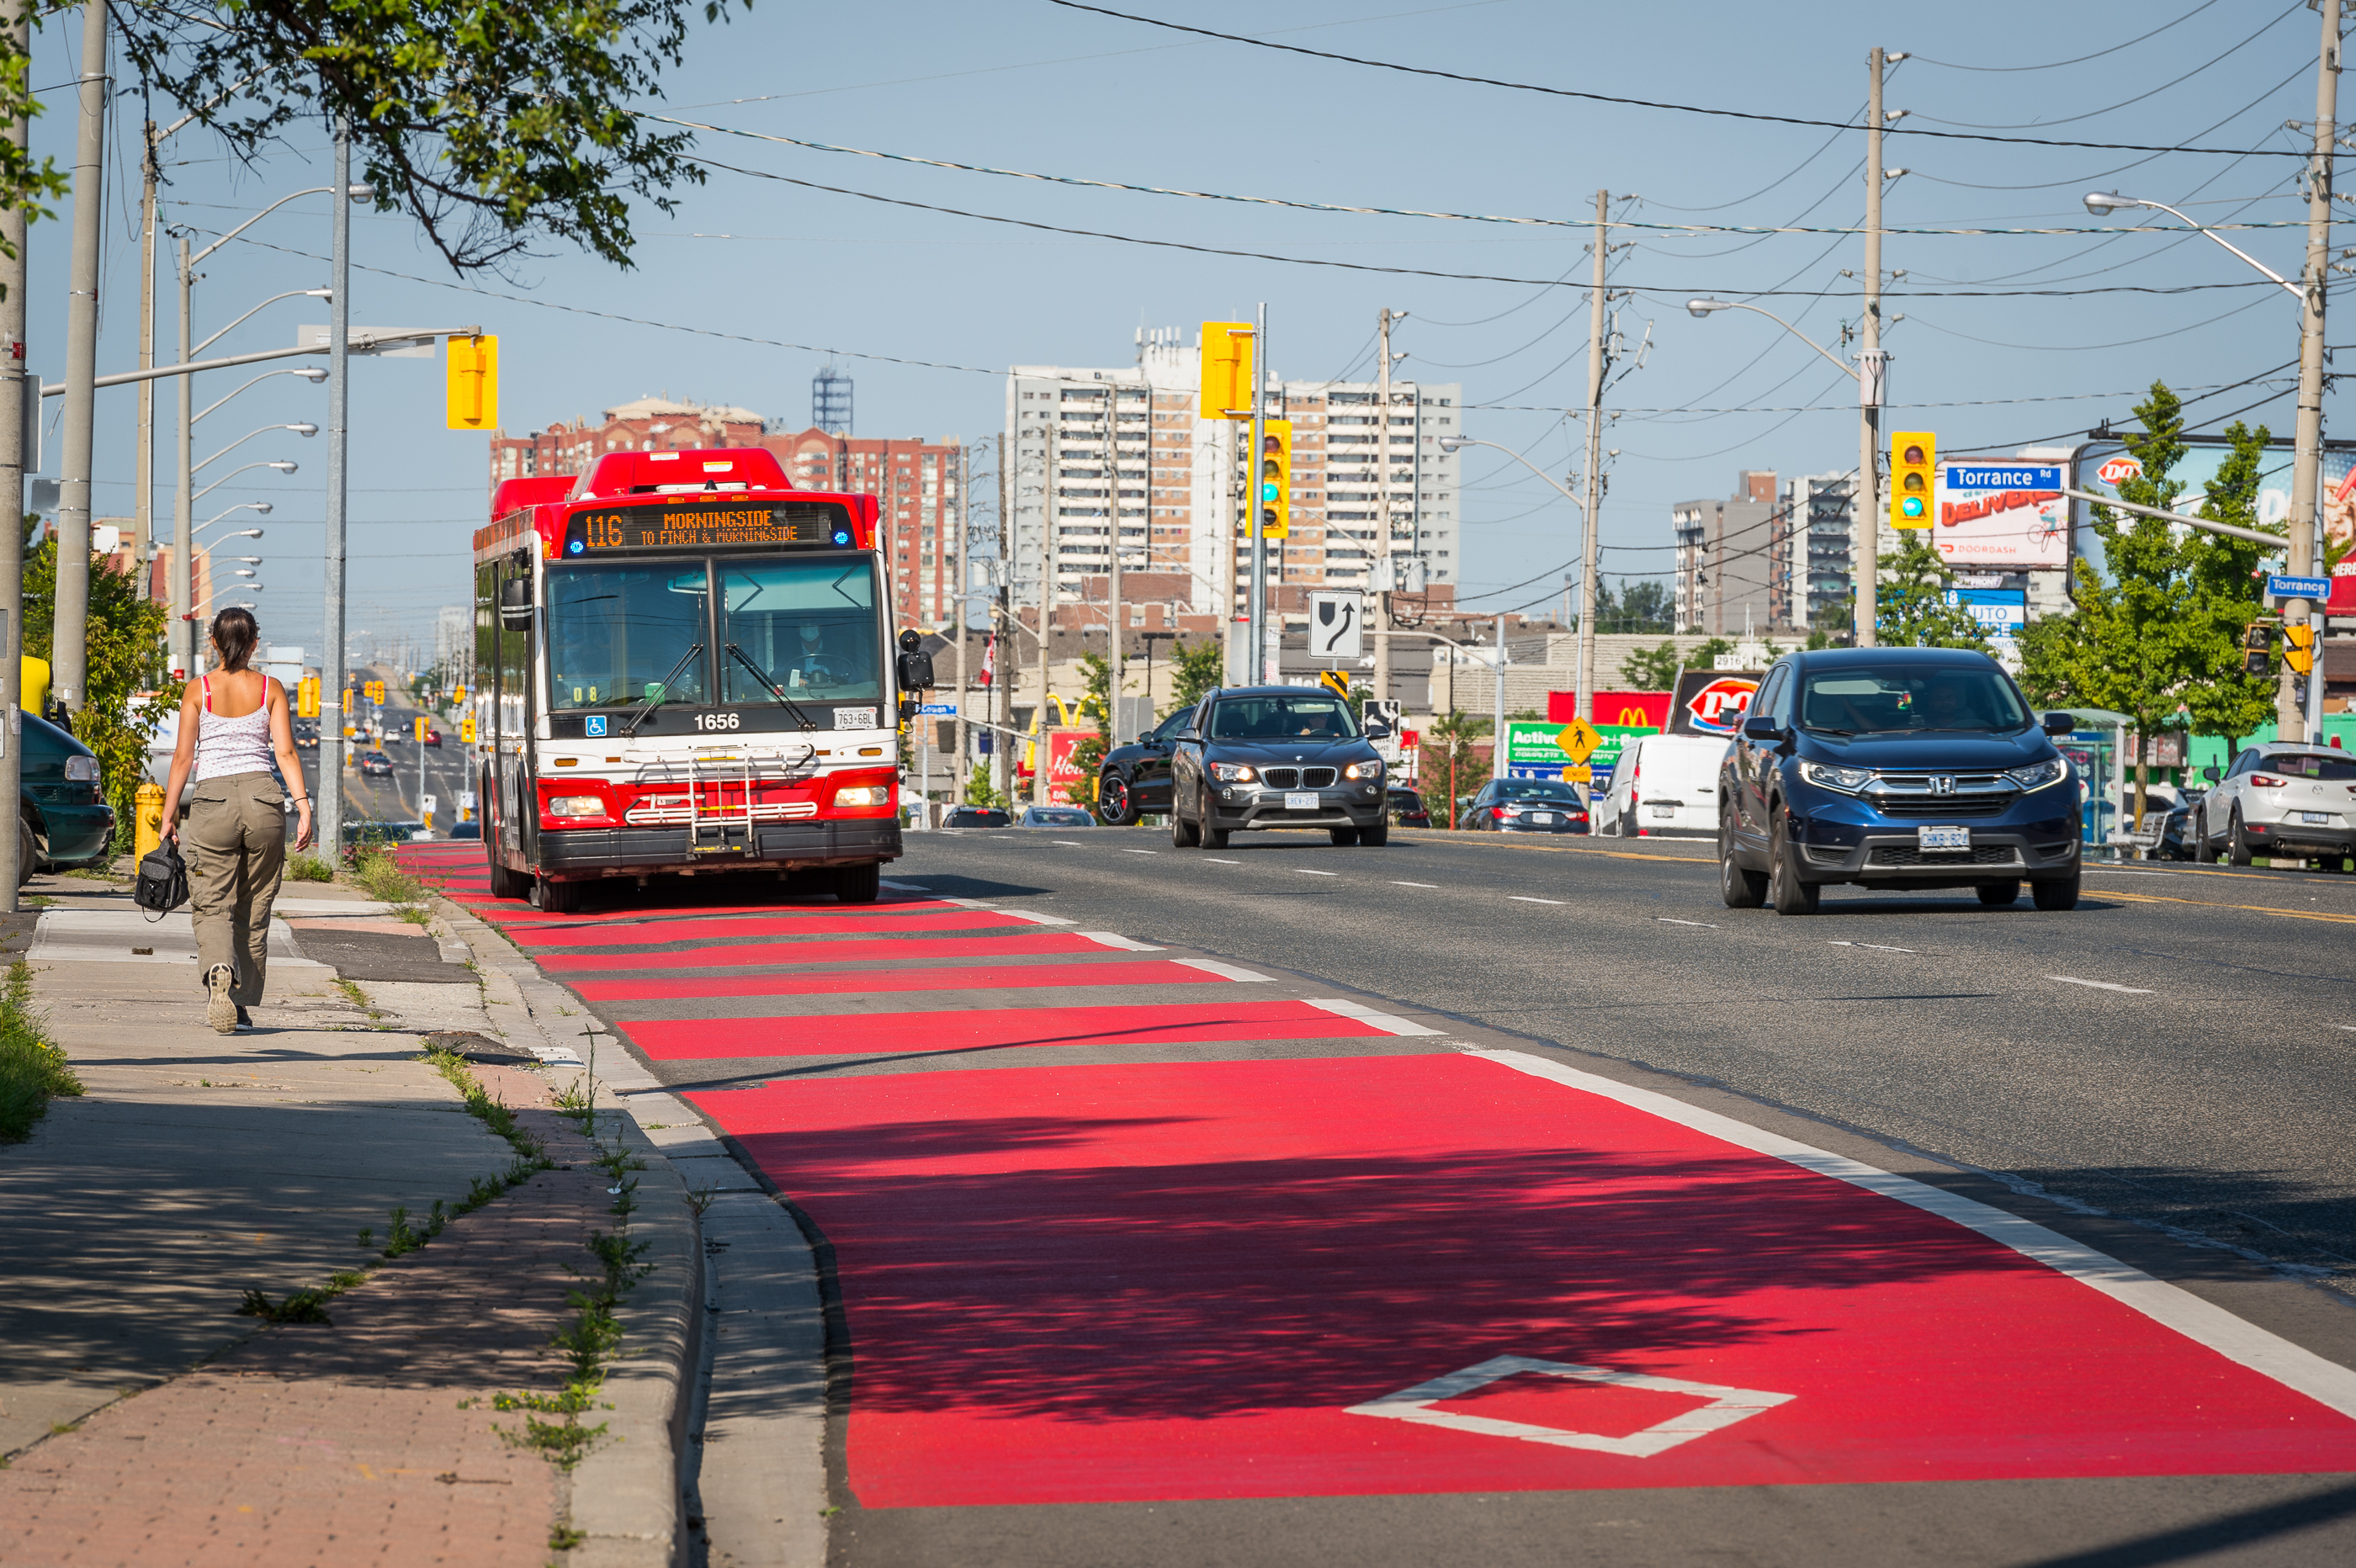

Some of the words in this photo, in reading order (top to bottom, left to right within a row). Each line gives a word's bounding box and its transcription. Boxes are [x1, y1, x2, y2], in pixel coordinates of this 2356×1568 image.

[1957, 469, 2032, 485] Torrance
[2040, 469, 2051, 479] Rd
[586, 515, 623, 547] 116
[664, 510, 772, 529] MORNINGSIDE
[641, 531, 655, 545] TO
[660, 530, 697, 545] FINCH
[702, 530, 711, 543] &
[716, 527, 798, 543] MORNINGSIDE
[2273, 579, 2326, 591] Torrance
[1717, 656, 1742, 665] 2916
[694, 712, 740, 730] 1656
[838, 713, 853, 724] 763
